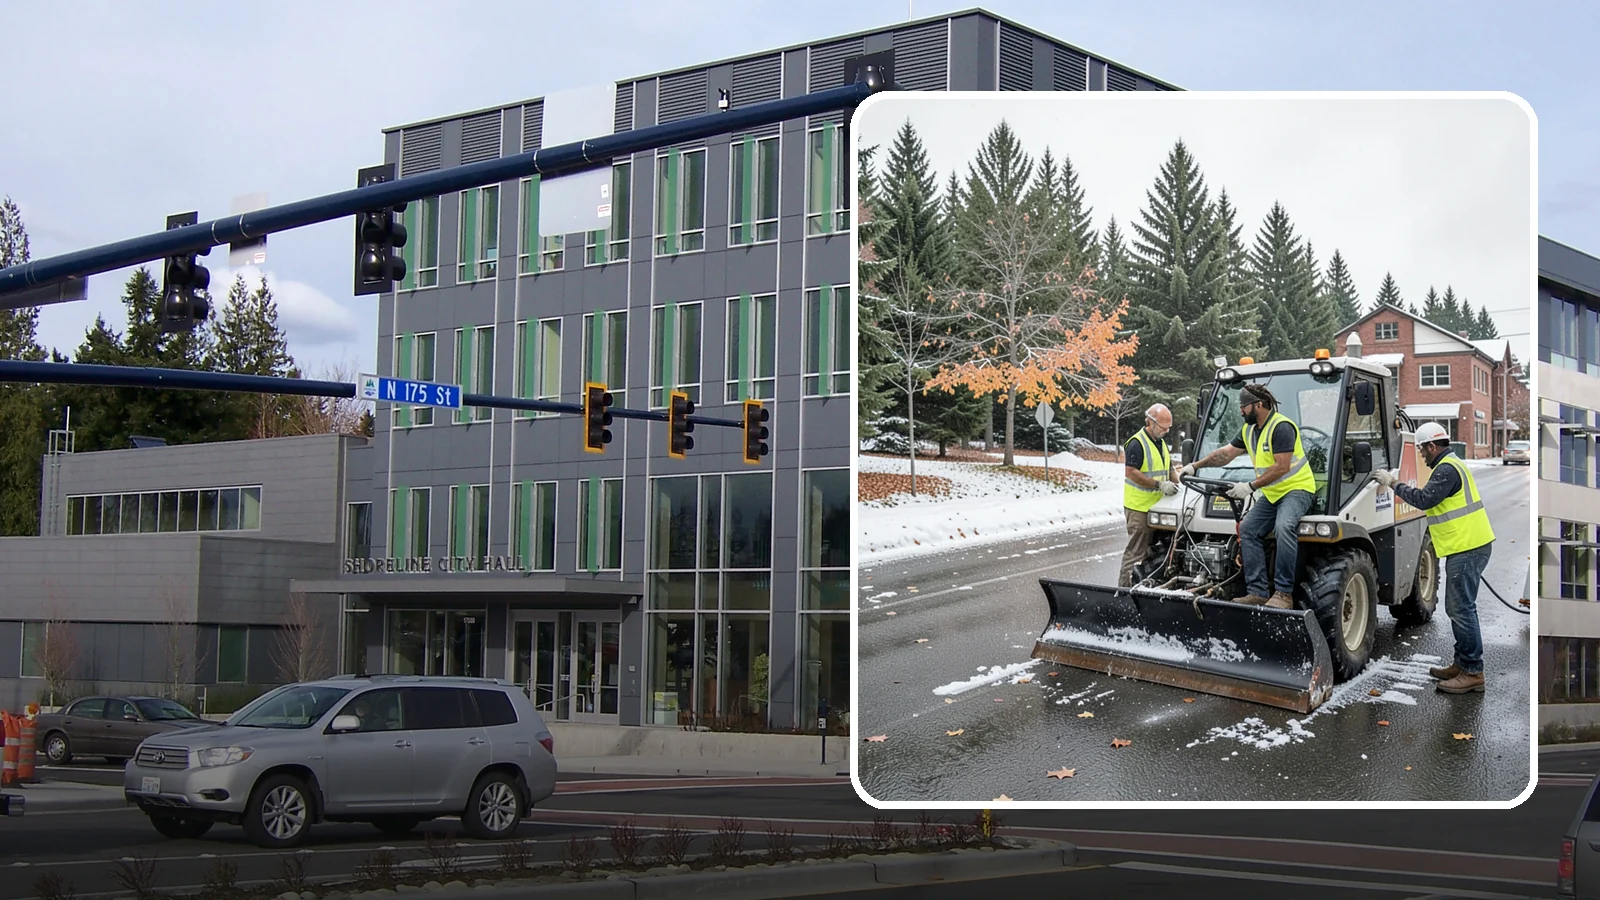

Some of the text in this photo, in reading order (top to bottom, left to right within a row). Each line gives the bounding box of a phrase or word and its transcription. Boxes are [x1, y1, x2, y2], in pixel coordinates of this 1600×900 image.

[387, 380, 451, 406] N 175 St
[344, 555, 525, 574] SHORELINE CITY HALL
